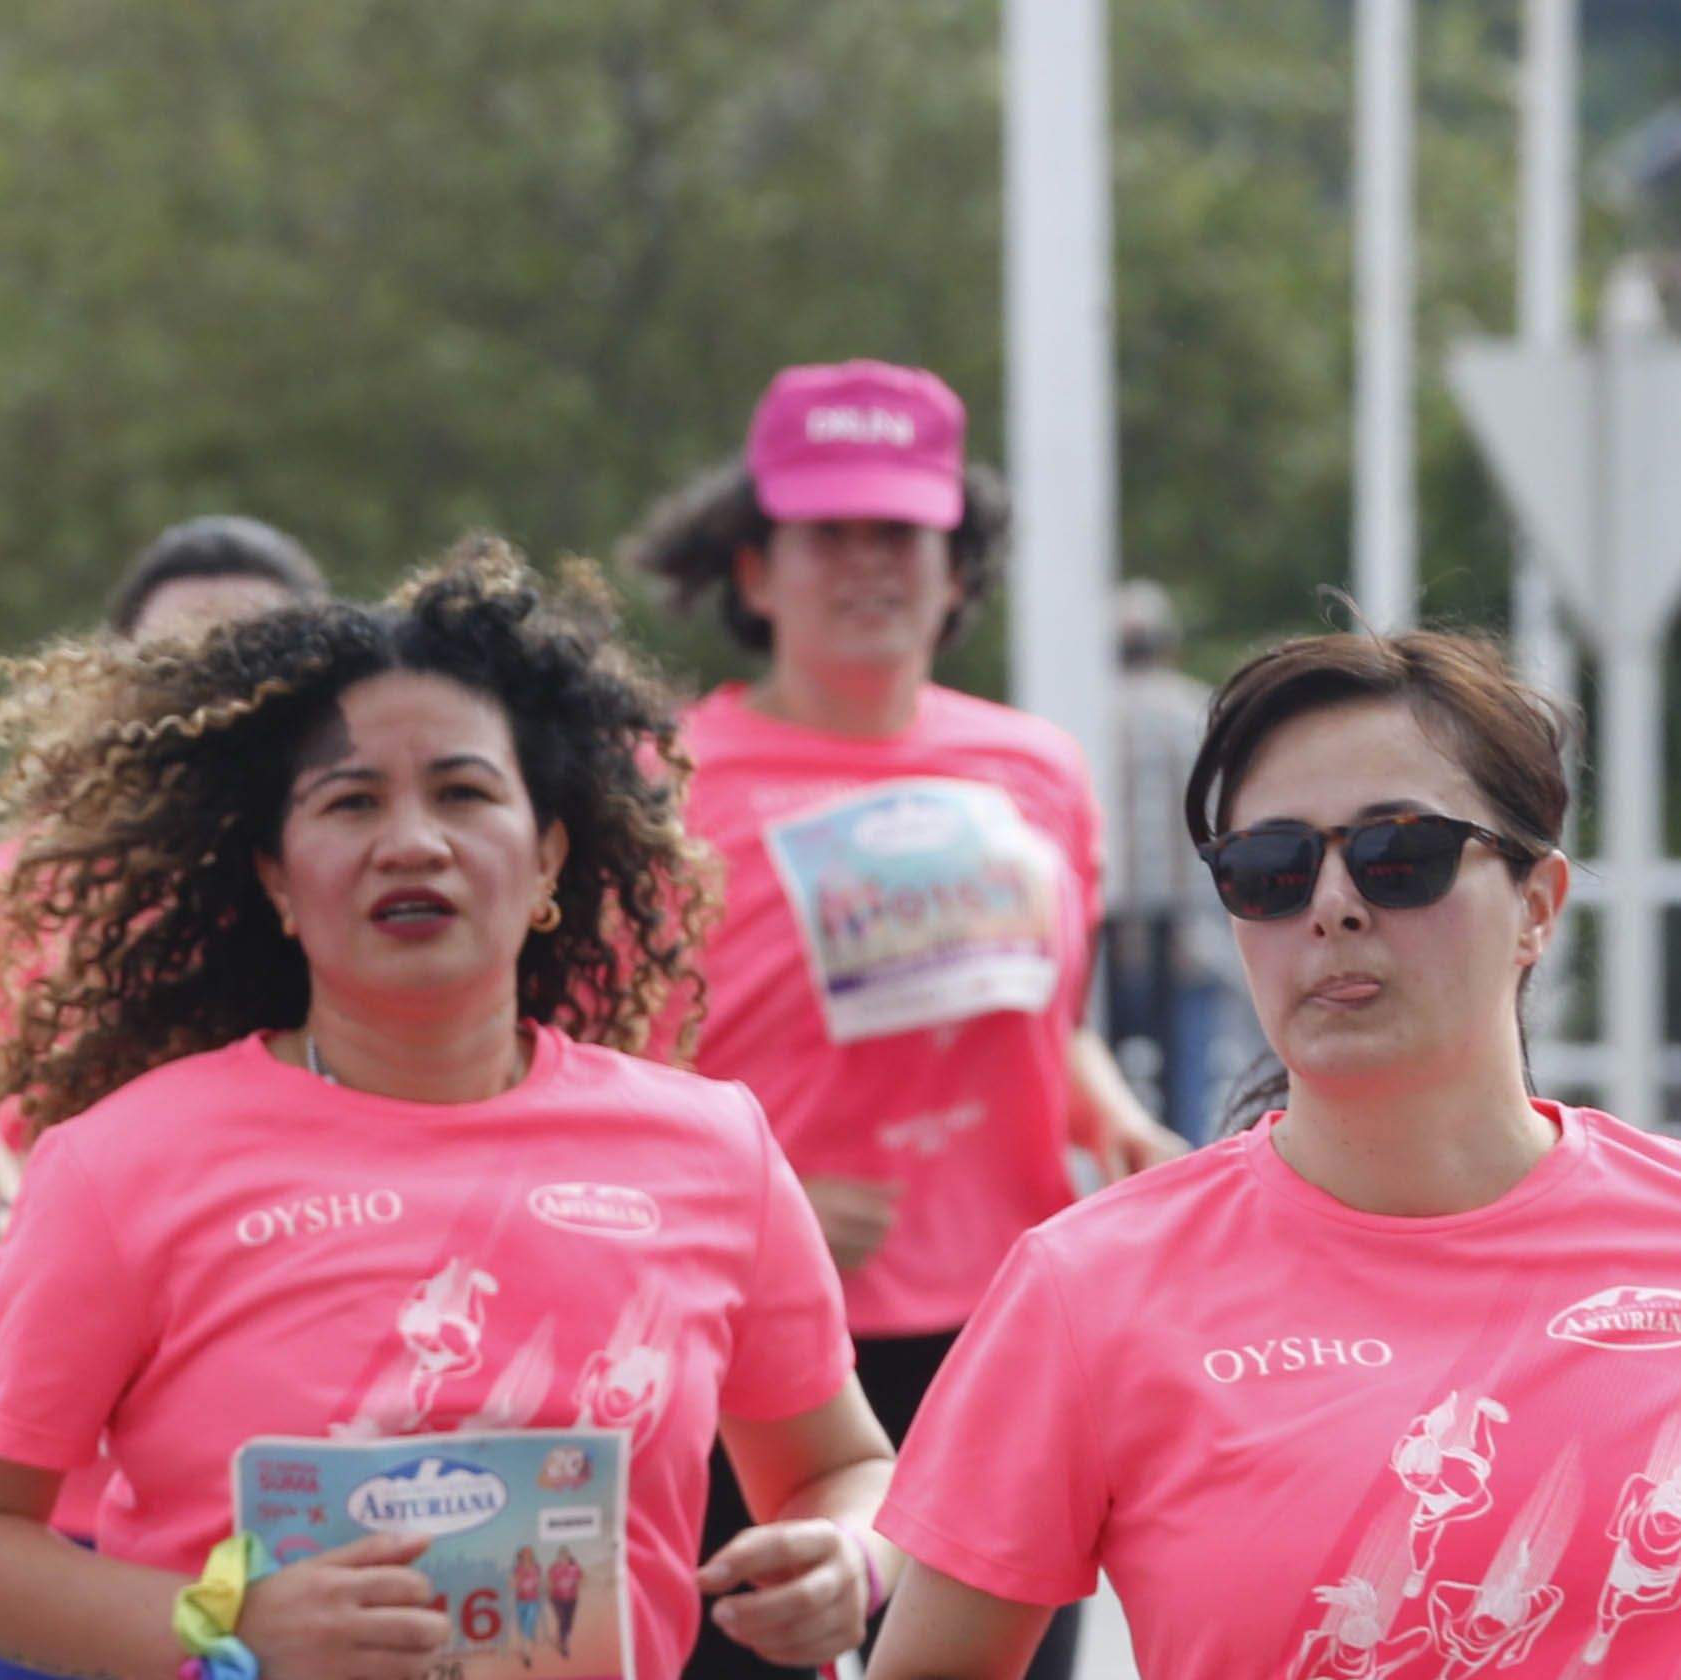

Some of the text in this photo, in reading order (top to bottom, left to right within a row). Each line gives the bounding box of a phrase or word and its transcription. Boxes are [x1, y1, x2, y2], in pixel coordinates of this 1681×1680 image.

[238, 1189, 402, 1247] OYSHO
[1562, 1311, 1681, 1336] ASTURIAN
[1203, 1336, 1393, 1384] OYSHO
[361, 1492, 497, 1521] ASTURIANA
